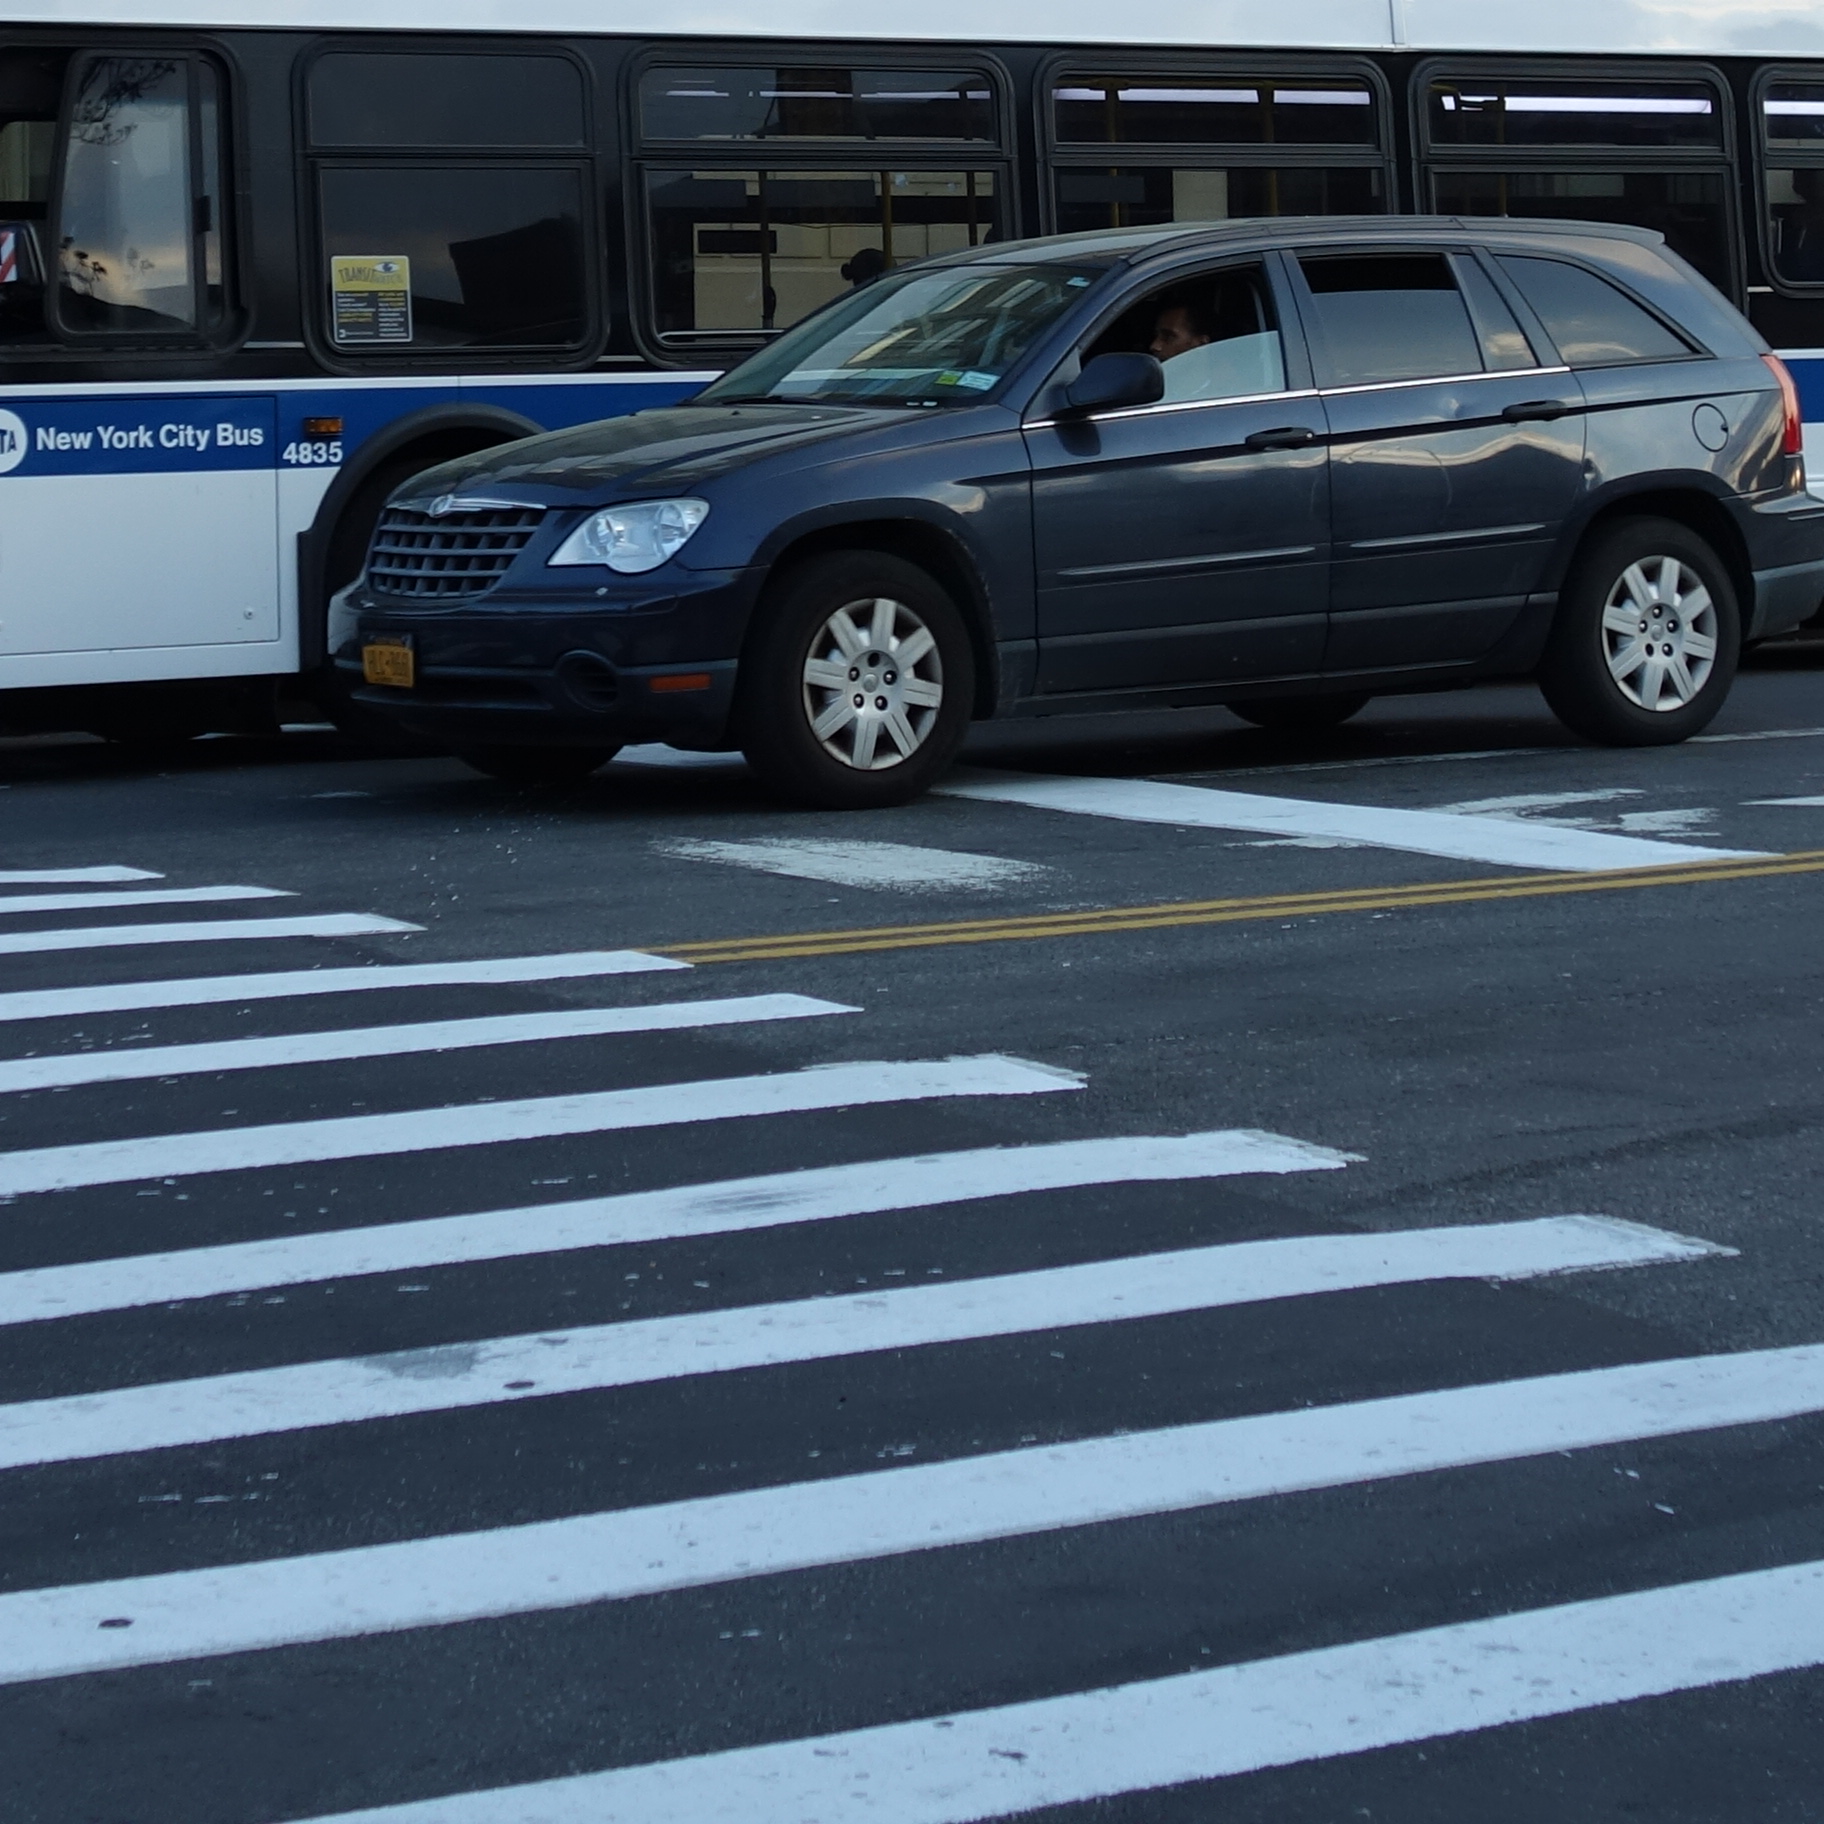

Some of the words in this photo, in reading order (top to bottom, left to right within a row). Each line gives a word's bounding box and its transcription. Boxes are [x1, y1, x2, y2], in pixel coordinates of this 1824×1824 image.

[36, 426, 92, 452] New
[97, 424, 155, 450] York
[158, 422, 211, 452] City
[216, 422, 265, 448] Bus
[282, 441, 344, 465] 4835
